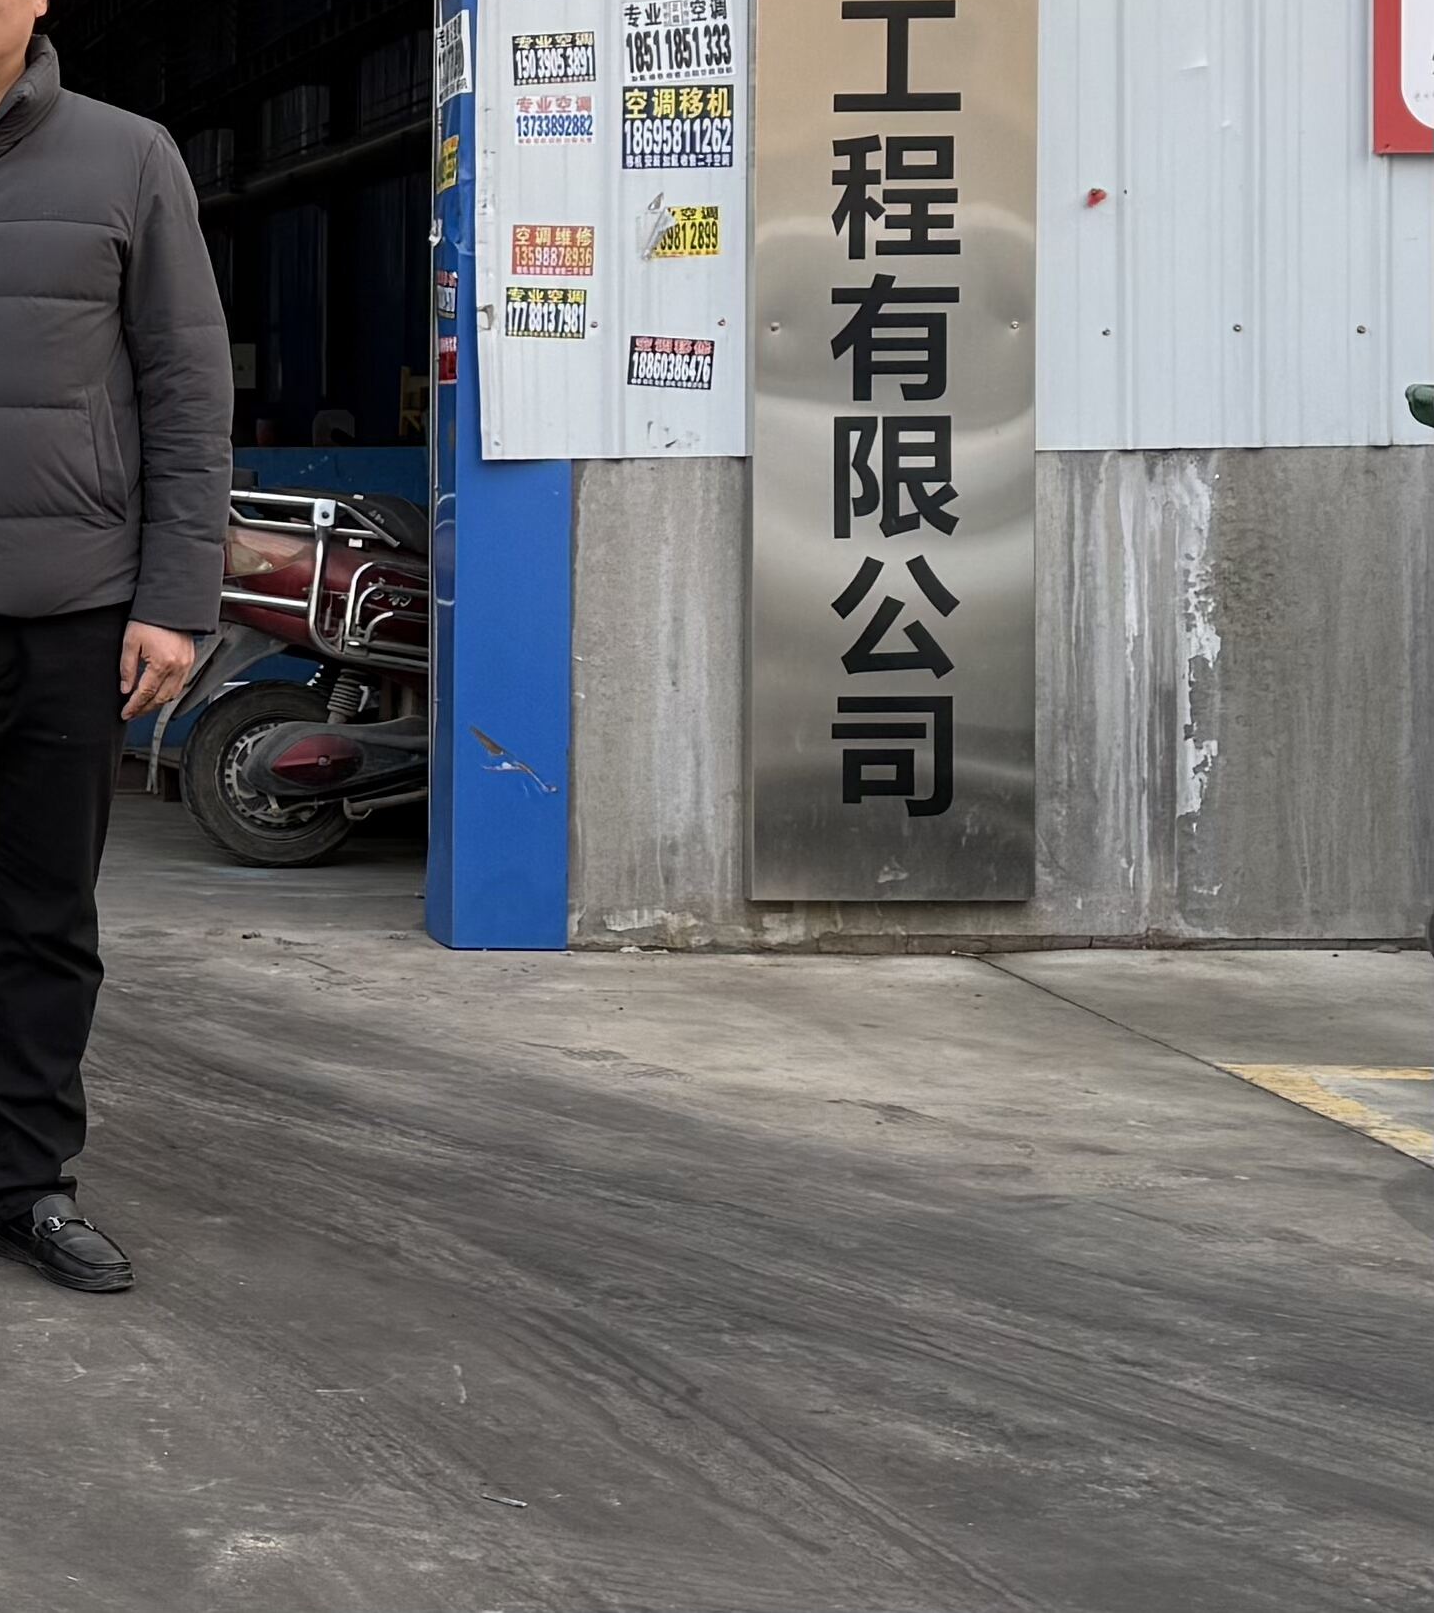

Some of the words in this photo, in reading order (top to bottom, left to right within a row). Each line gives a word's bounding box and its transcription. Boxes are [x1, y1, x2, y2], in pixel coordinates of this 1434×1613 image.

[626, 29, 662, 73] 1851
[665, 26, 701, 70] 1851
[703, 23, 732, 67] 333
[624, 87, 732, 119] 空调移机
[516, 114, 593, 137] 13733892882
[624, 118, 732, 155] 18695811262
[690, 221, 718, 250] 2899
[632, 351, 711, 383] 18860386476
